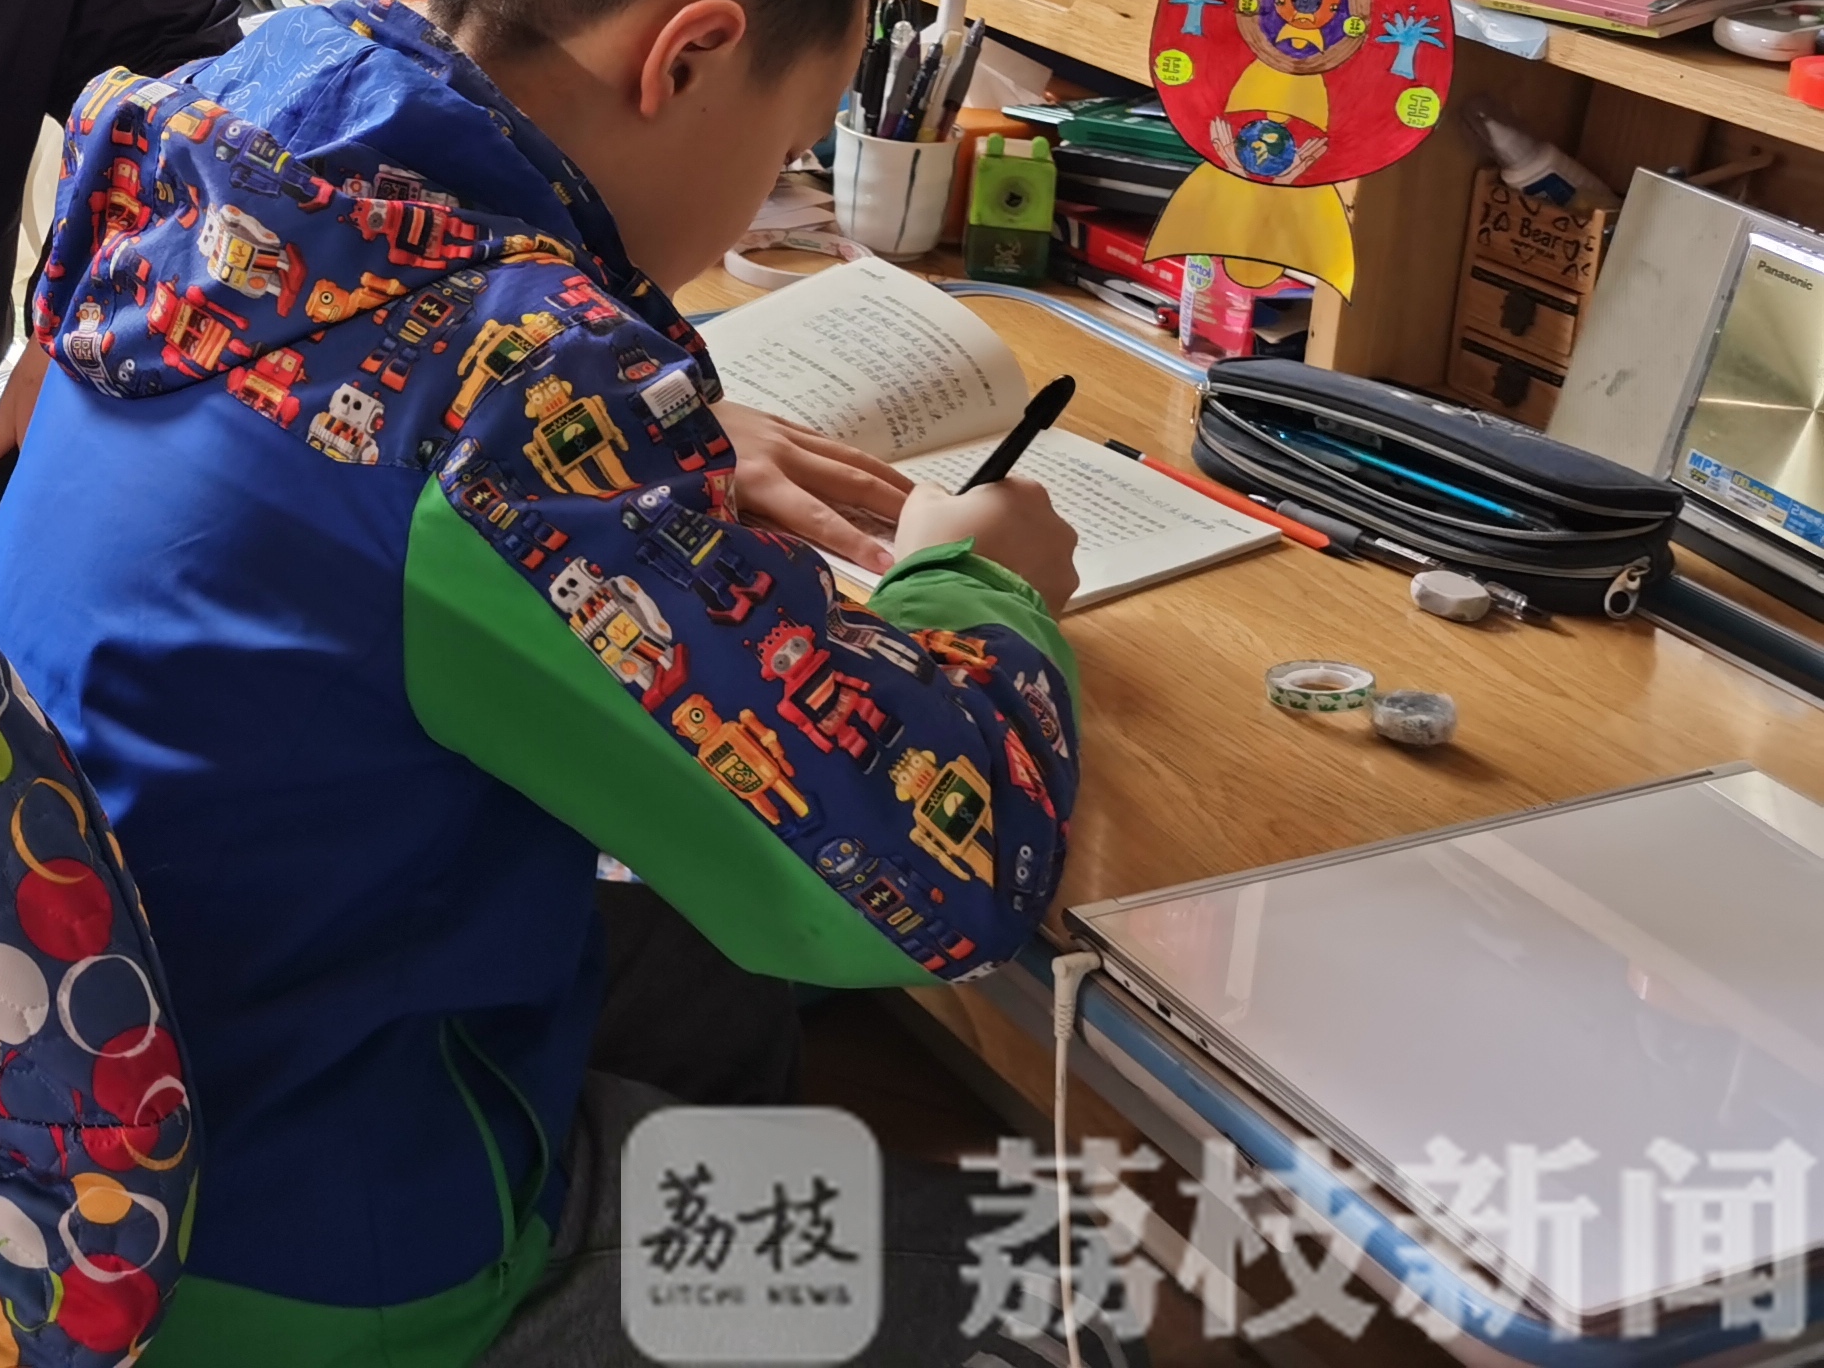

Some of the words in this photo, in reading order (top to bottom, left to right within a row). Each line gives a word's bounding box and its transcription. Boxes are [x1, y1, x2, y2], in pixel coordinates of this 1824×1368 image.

[1519, 216, 1562, 249] Bear
[1756, 259, 1814, 291] Panasonic
[1688, 452, 1723, 478] MP3
